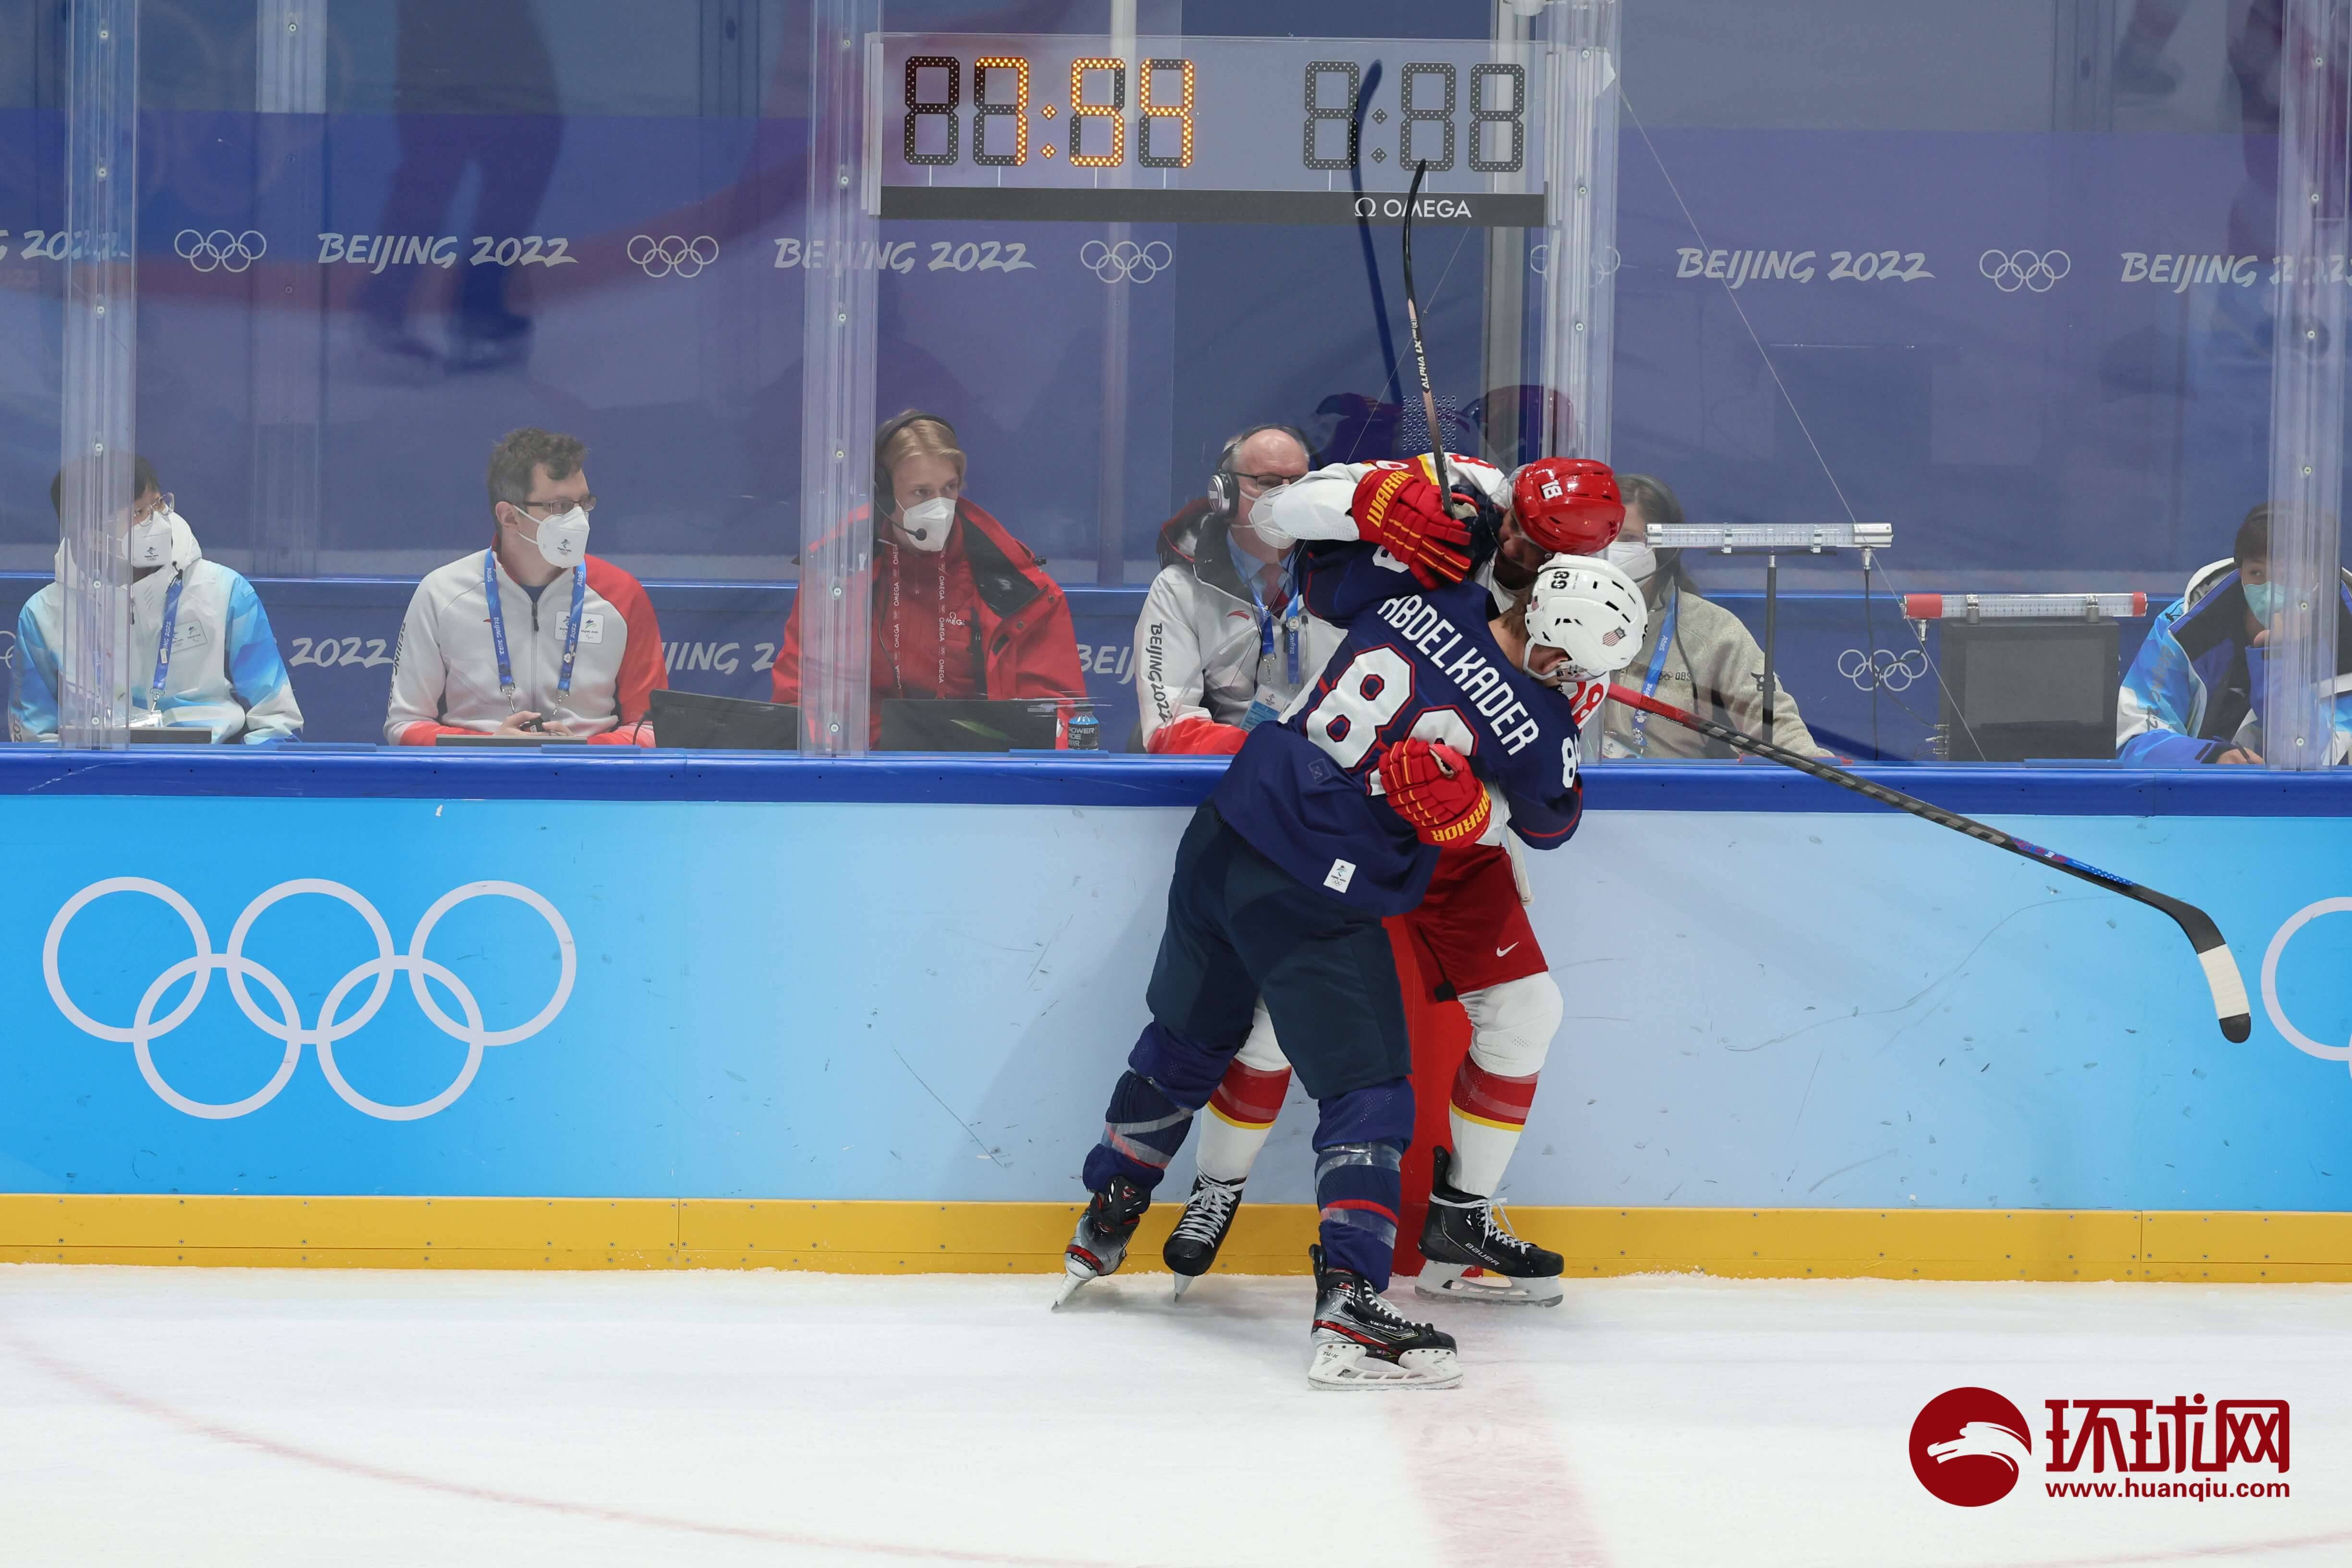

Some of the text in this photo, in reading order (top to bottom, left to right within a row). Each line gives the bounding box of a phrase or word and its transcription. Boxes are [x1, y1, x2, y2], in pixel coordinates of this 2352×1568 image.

[1384, 199, 1472, 218] OMEGA
[318, 233, 579, 274] BEIJING 2022
[928, 241, 1037, 272] 2022
[1676, 248, 1936, 289] BEIJING 2022
[2121, 253, 2258, 293] BEIJING
[1414, 340, 1423, 353] LX
[1418, 355, 1430, 389] ALPHA
[1541, 479, 1563, 500] 18
[1551, 571, 1569, 589] 89
[289, 637, 394, 668] 2022
[1076, 644, 1135, 685] BEIJ
[1146, 623, 1173, 723] BEIJING 2022
[1377, 594, 1539, 756] ABDELKADER
[1675, 672, 1691, 681] OBS
[1465, 1242, 1500, 1266] BAUER
